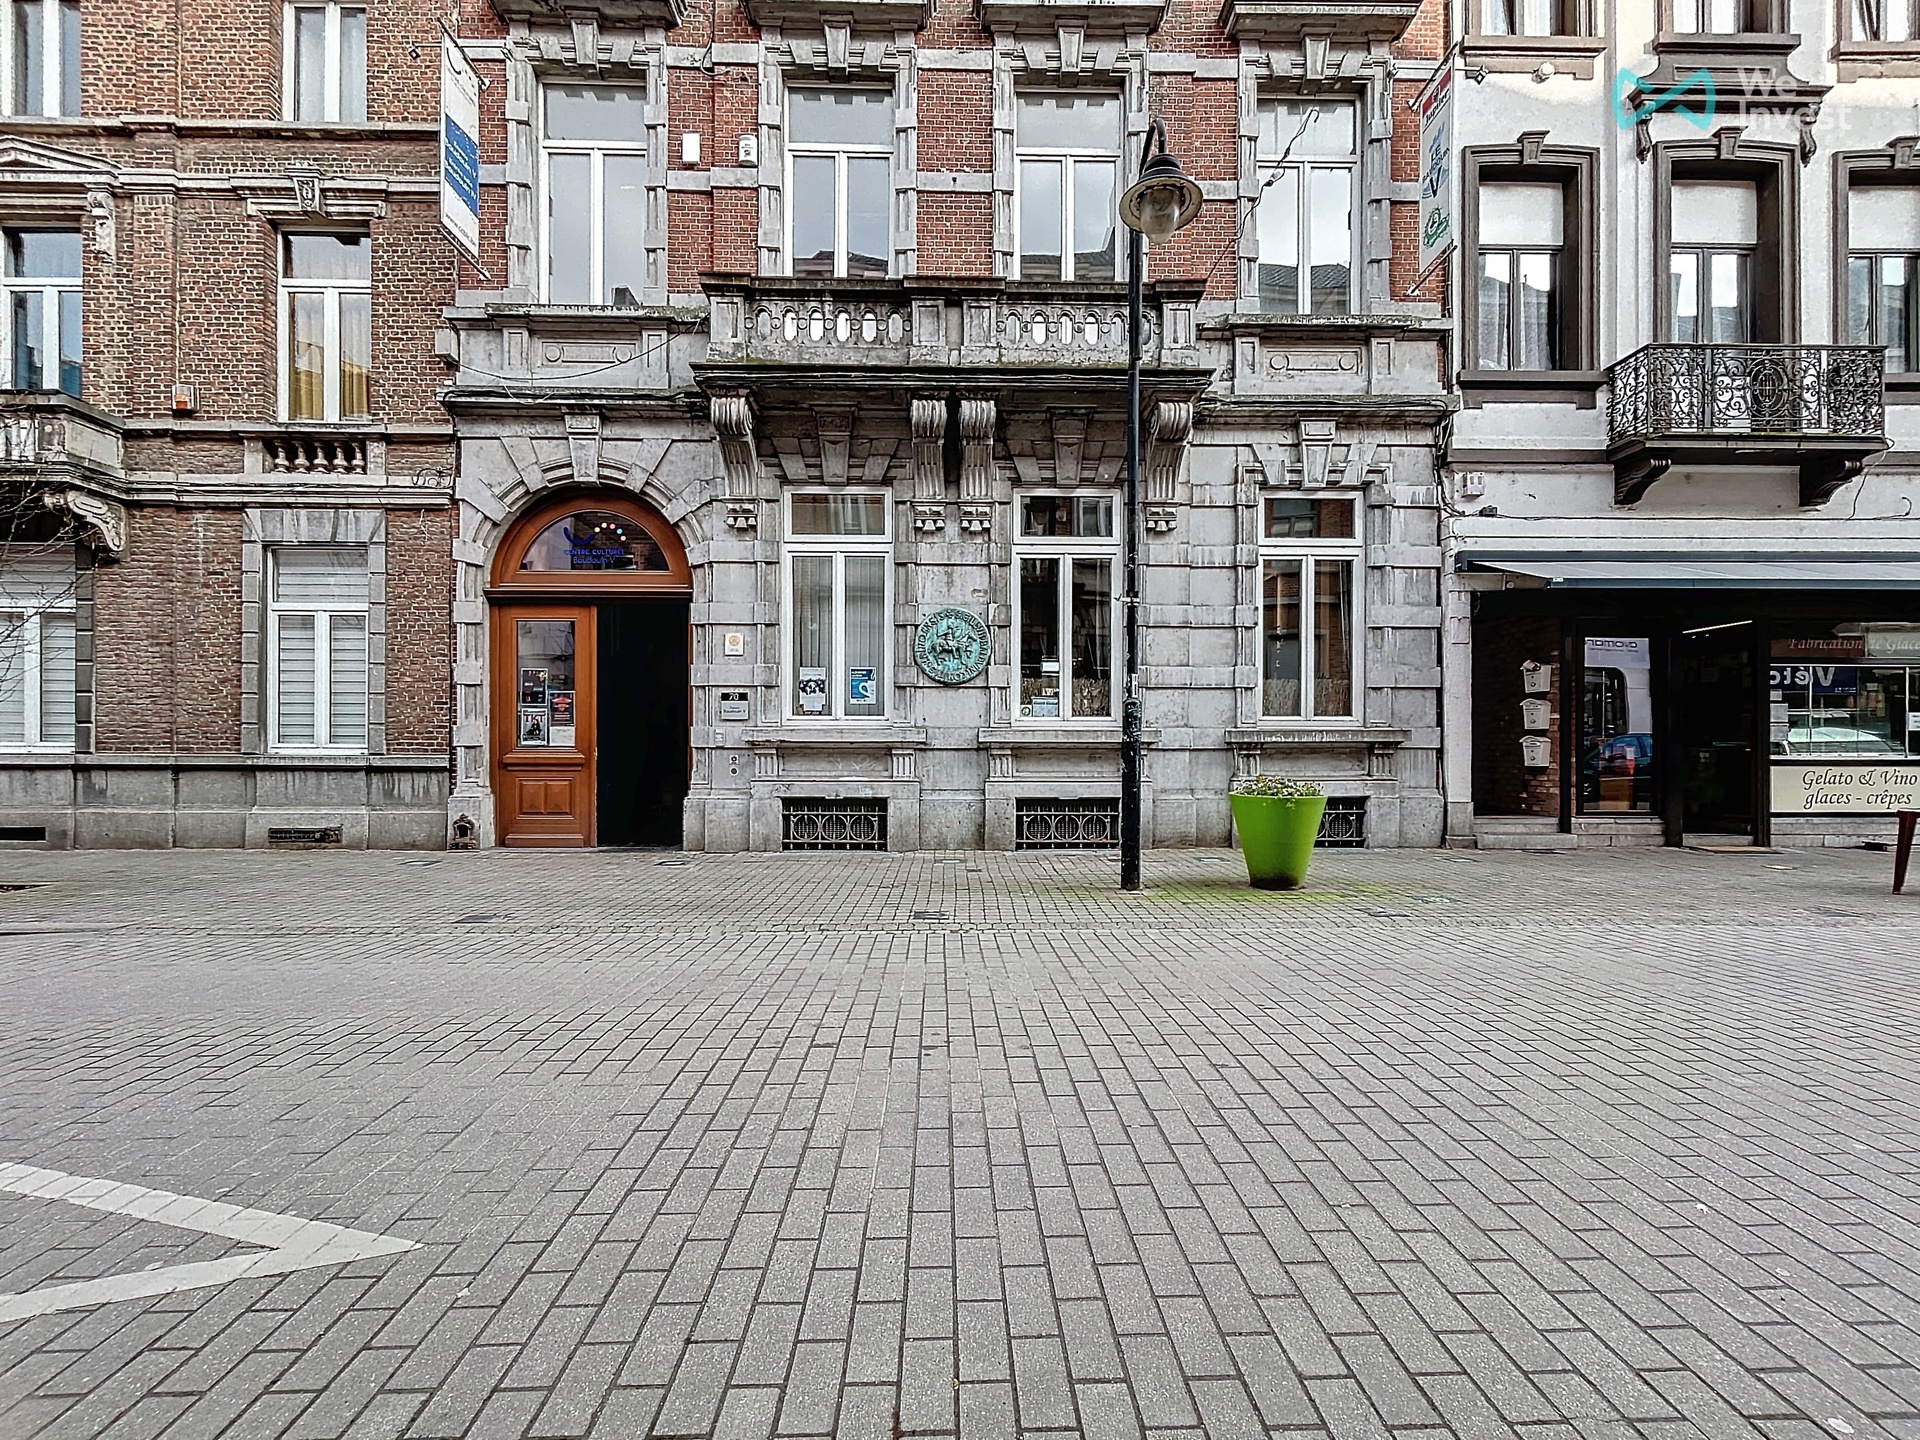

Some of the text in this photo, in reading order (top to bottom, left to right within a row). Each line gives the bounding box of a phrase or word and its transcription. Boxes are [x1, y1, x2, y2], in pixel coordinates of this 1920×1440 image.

[1424, 87, 1450, 127] Jupiler
[1430, 143, 1441, 162] LE
[1429, 164, 1443, 198] V
[1788, 638, 1863, 650] Fabrication
[728, 692, 739, 701] 70
[1802, 768, 1918, 791] Gelato & Vino
[1803, 788, 1852, 810] glaces
[1866, 789, 1913, 810] crêpes
